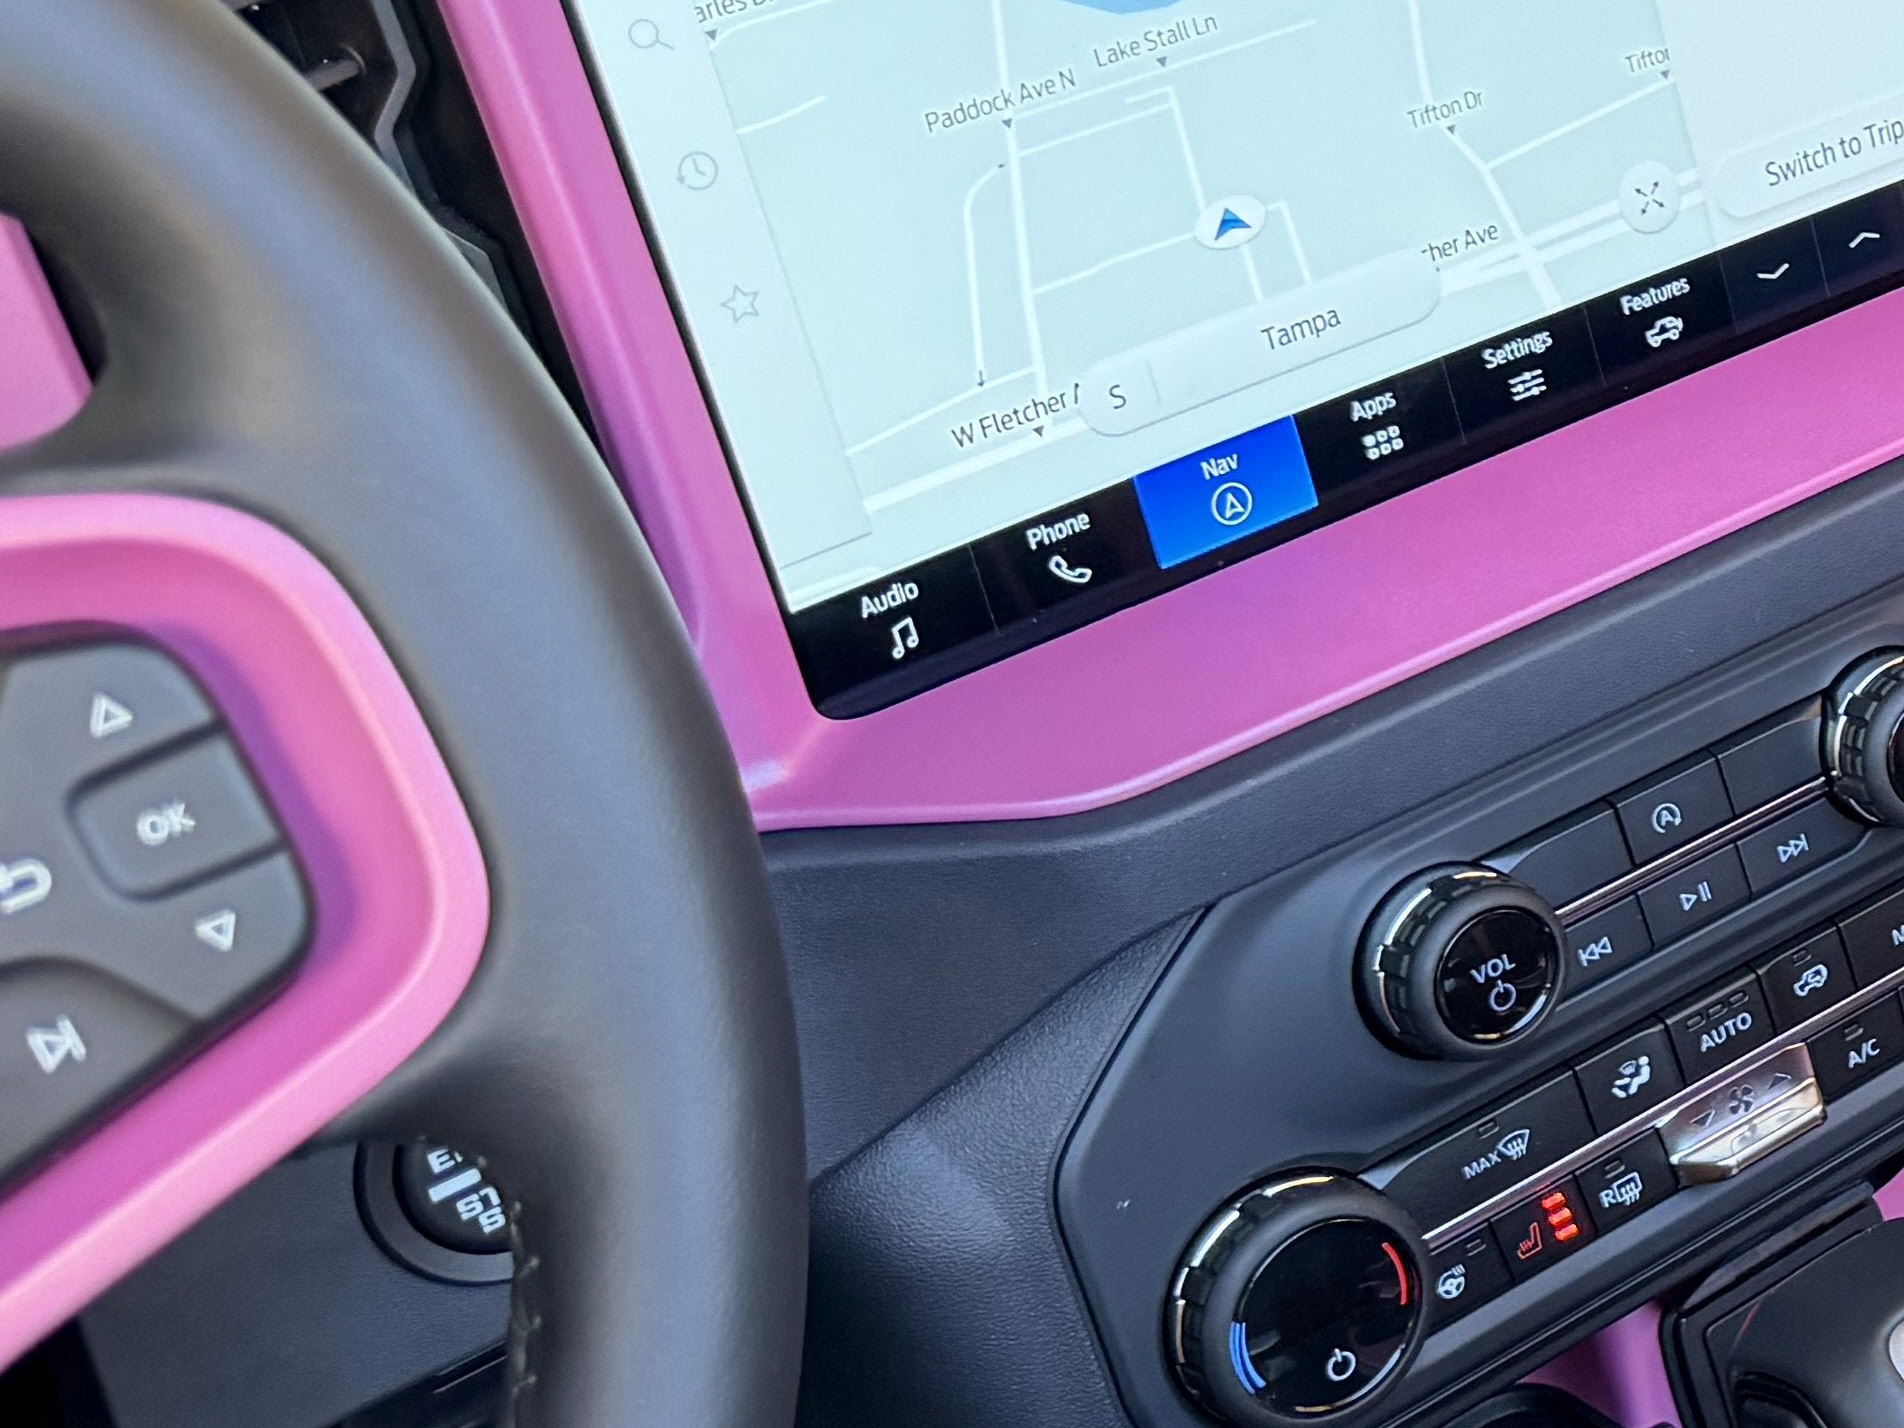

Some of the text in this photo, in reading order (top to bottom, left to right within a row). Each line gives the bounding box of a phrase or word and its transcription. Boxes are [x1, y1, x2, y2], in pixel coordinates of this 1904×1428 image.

[1094, 13, 1218, 67] Lake Stall Ln
[925, 68, 1076, 133] Paddock Ave N
[1407, 89, 1484, 129] Tifton Dr
[1765, 140, 1836, 187] Switch
[1839, 137, 1861, 160] to
[1863, 120, 1904, 152] Trip
[1465, 225, 1498, 249] Ave
[1620, 278, 1690, 316] Features
[1261, 309, 1341, 351] Tampa
[1482, 330, 1553, 369] Settings
[1109, 384, 1127, 410] S
[1350, 390, 1396, 422] Apps
[951, 422, 974, 448] W
[979, 392, 1066, 439] Fletcher
[1201, 451, 1239, 480] Nav
[1026, 510, 1090, 550] Phone
[860, 581, 919, 618] Audio
[137, 802, 196, 846] OK
[1471, 954, 1515, 986] VOL
[1699, 1011, 1753, 1052] AUTO
[1847, 1036, 1880, 1068] A/C
[1462, 1149, 1501, 1181] MAX
